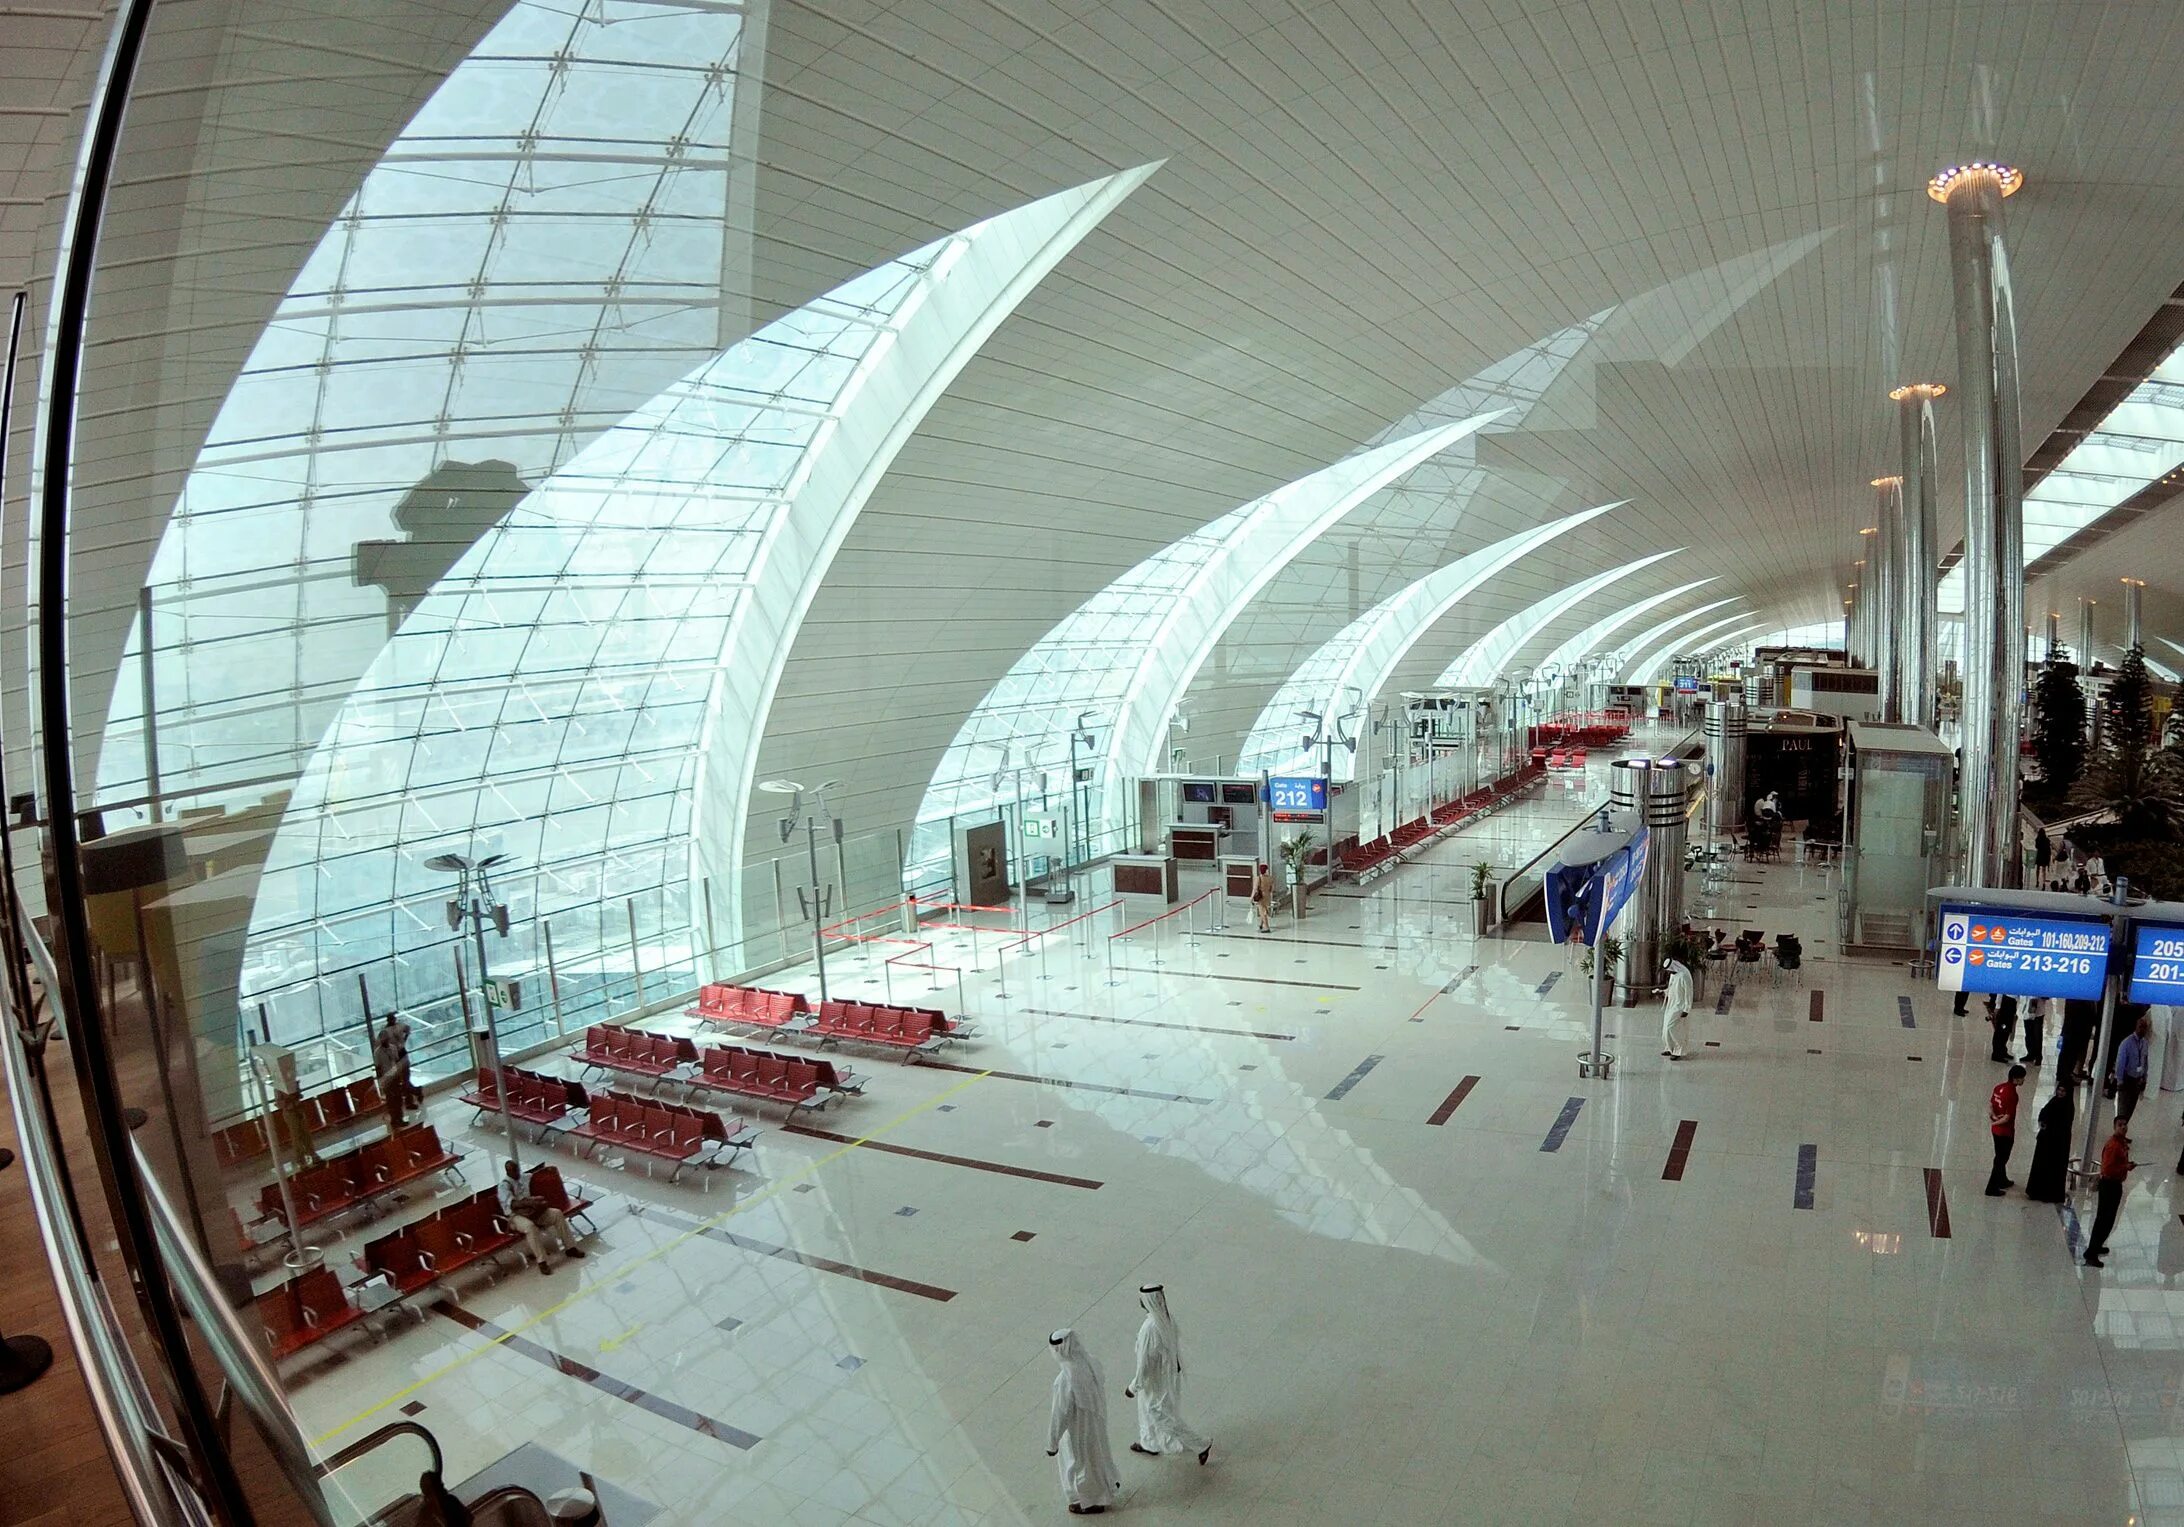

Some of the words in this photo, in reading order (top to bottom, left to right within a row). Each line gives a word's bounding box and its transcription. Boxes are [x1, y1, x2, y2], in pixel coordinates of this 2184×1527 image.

[1782, 739, 1813, 751] PAUL
[1275, 790, 1308, 806] 212
[2008, 927, 2041, 938] البوابات
[2007, 936, 2034, 947] Gates
[2041, 931, 2105, 952] 101-160,209-212
[2152, 939, 2184, 958] 205
[1987, 950, 2020, 960] البوابات
[1986, 959, 2013, 969] Gates
[2020, 954, 2091, 974] 213-216
